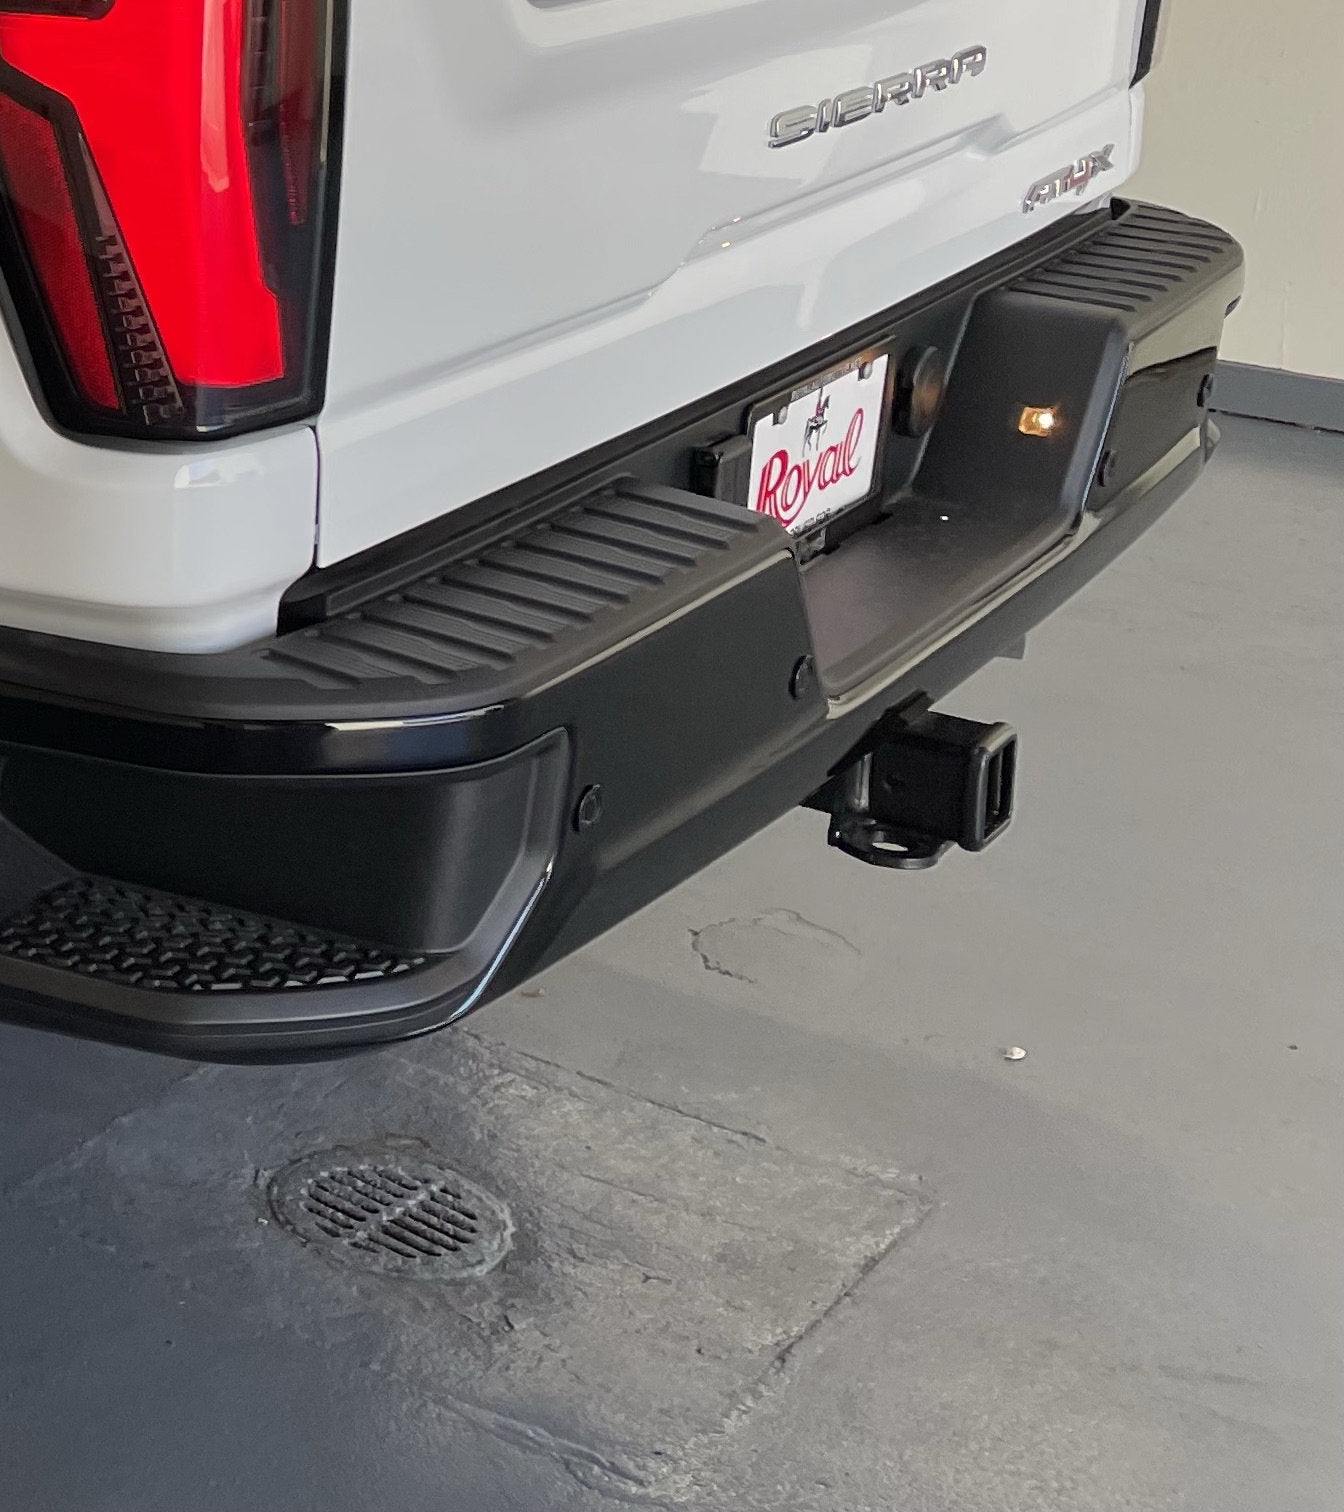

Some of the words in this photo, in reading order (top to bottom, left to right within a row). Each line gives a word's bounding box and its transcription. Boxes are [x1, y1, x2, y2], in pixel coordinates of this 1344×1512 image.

[767, 44, 987, 148] SIERRA
[1022, 143, 1114, 214] AT4X
[755, 407, 864, 528] Royal
